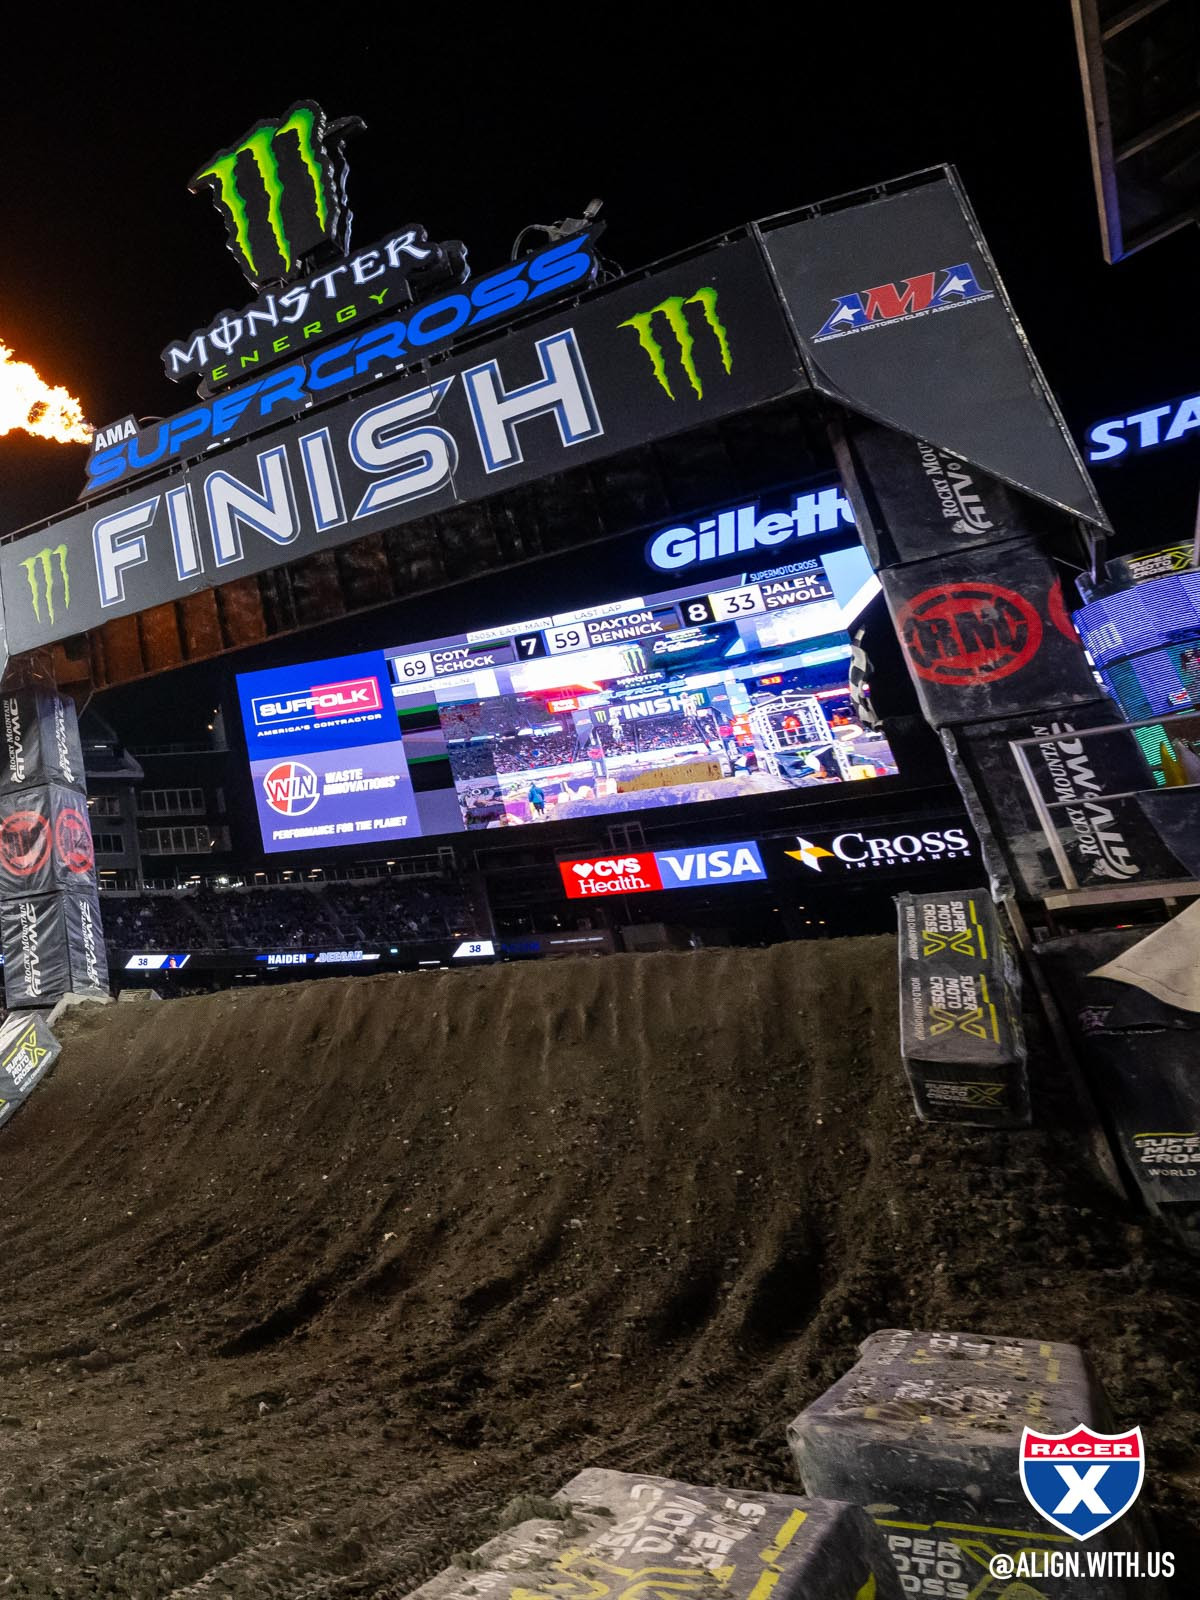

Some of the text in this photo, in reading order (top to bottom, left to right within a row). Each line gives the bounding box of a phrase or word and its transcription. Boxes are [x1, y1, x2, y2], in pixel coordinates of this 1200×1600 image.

[167, 231, 432, 372] MONSTER
[810, 263, 994, 340] AMA
[813, 293, 995, 344] AMERICAN MOTORCYCLIST ASSOCIATION
[212, 288, 390, 381] ENERGY
[86, 234, 592, 491] SUPERCROSS
[94, 419, 137, 451] AMA
[91, 328, 604, 609] FINISH
[932, 477, 961, 518] ROCKY
[749, 559, 818, 582] SUPERMOTOCROSS
[761, 575, 819, 596] JALEK
[726, 594, 756, 614] 33
[766, 589, 833, 608] SWOLL
[574, 604, 622, 620] LAST LAP
[587, 611, 654, 634] DAXTON
[688, 604, 708, 621] 8
[525, 620, 550, 632] MAIN
[590, 621, 664, 645] BENNICK
[520, 638, 538, 655] 7
[554, 631, 580, 649] 59
[432, 648, 470, 663] COTY
[434, 654, 495, 674] SCHOCK
[403, 661, 426, 677] 69
[259, 688, 370, 717] SUFFOLK
[3, 700, 14, 743] MOUNTAIN
[257, 713, 382, 737] AMERICA'S CONTRACTOR
[268, 775, 313, 801] WIN
[325, 768, 363, 783] WASTE
[273, 816, 407, 840] PERFORMANCE FOR THE PLANET
[1065, 806, 1102, 856] ROCKY
[594, 857, 641, 877] CVS
[663, 850, 762, 881] VISA
[845, 849, 971, 870] INSURANCE
[905, 905, 917, 923] WORLD
[923, 904, 938, 933] CROSS
[937, 904, 953, 932] MOTO
[950, 901, 968, 932] SUPER
[19, 903, 31, 953] MOUNTAIN
[268, 954, 307, 965] HAIDEN
[469, 944, 482, 953] 38
[23, 953, 32, 984] ROCKY
[138, 958, 148, 966] 38
[929, 976, 946, 1010] CROSS
[945, 977, 962, 1009] MOTO
[960, 975, 978, 1011] SUPER
[910, 977, 926, 1041] WORLD CHAMPIONSHIP
[5, 1049, 27, 1074] SUPER
[12, 1055, 30, 1079] MOTO
[14, 1061, 34, 1086] CROSS
[1148, 1168, 1197, 1177] WORLD
[630, 1496, 707, 1555] MOTO
[884, 1533, 962, 1560] PER
[893, 1553, 960, 1579] OTO
